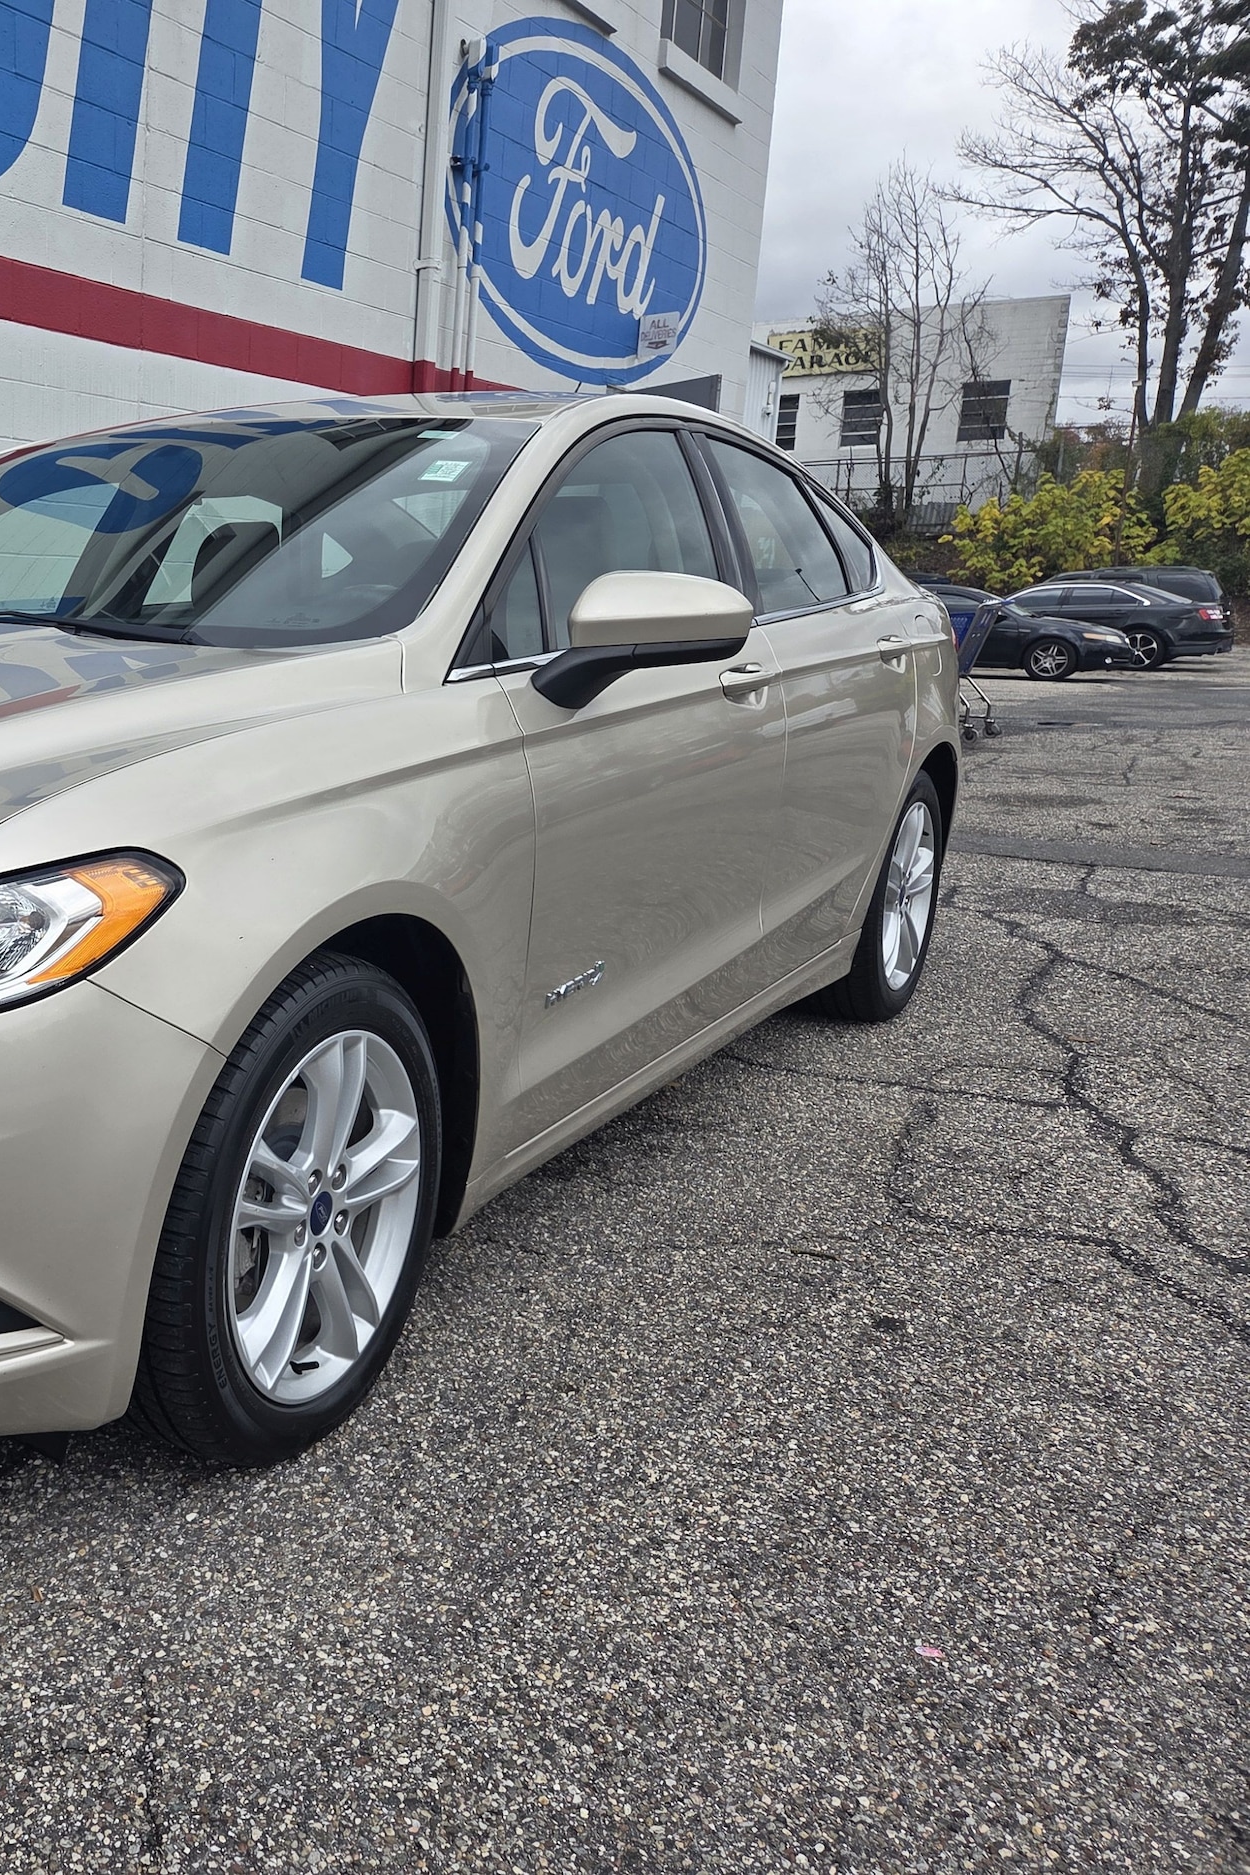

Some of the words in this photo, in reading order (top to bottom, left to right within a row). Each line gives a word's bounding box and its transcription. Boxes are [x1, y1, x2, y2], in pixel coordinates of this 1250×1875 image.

[509, 76, 666, 321] Ford
[650, 319, 670, 330] ALL
[783, 351, 876, 372] ARAGE
[207, 1322, 228, 1390] ENERGY
